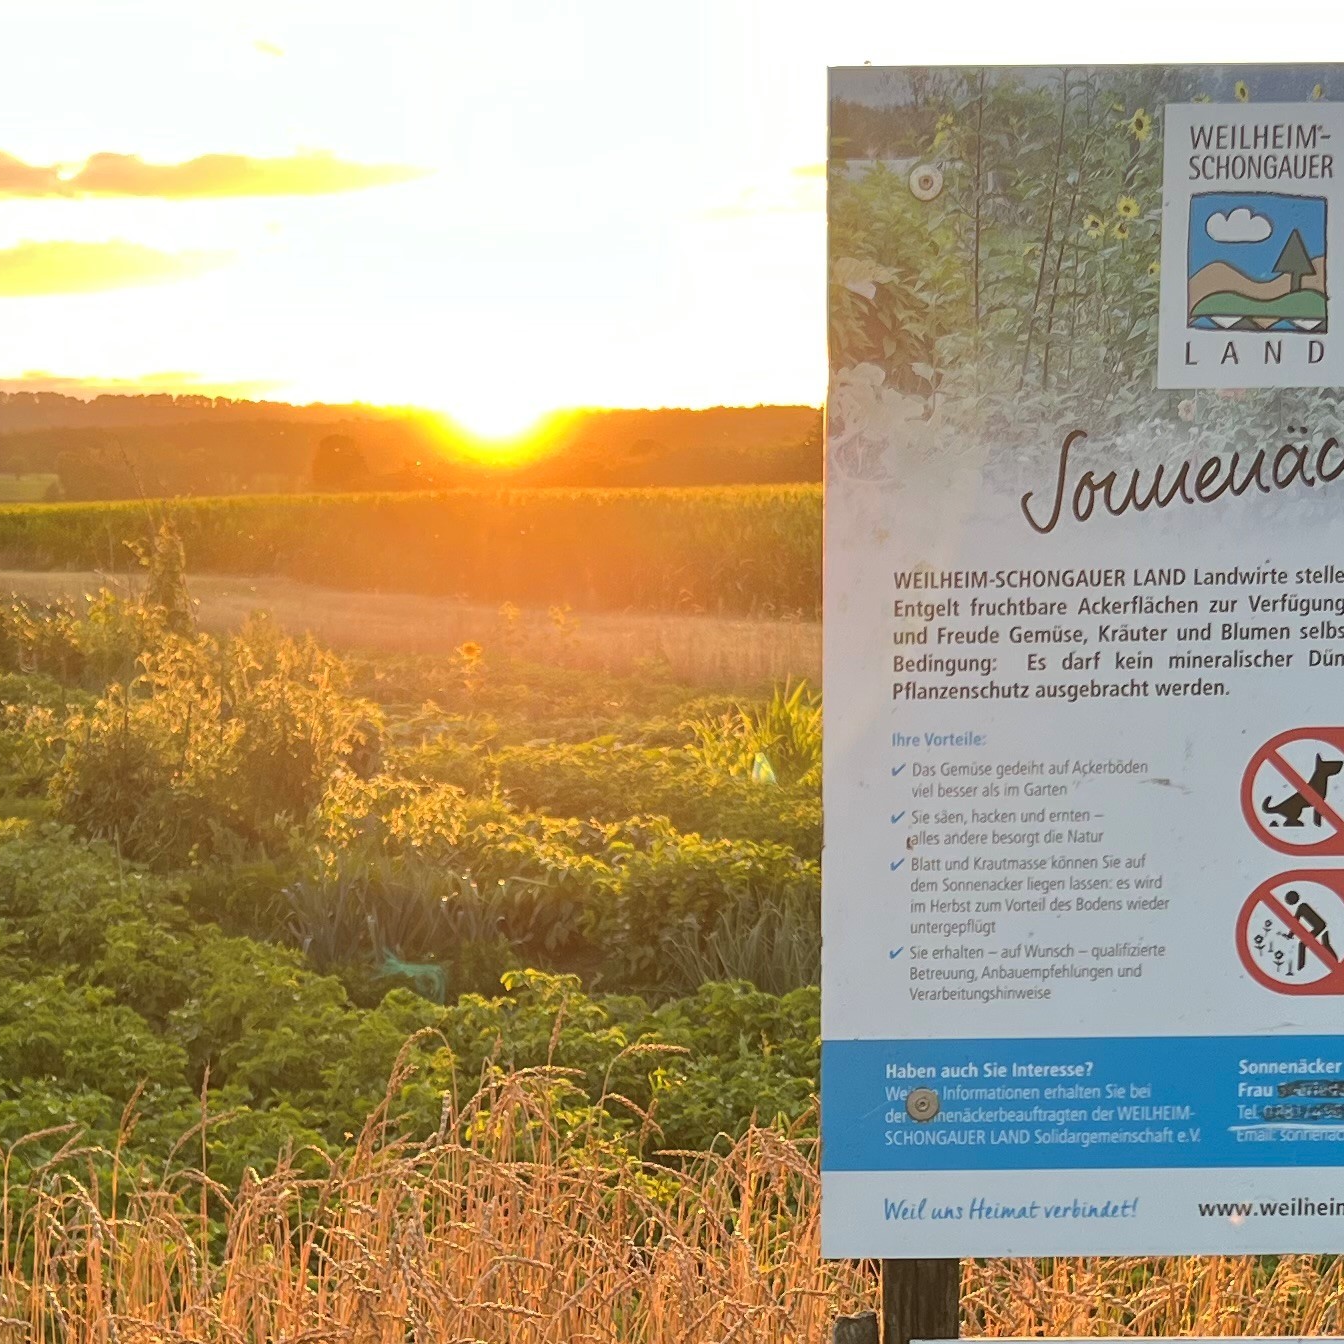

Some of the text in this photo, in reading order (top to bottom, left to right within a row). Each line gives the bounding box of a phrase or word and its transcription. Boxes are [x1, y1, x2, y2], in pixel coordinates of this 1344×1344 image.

[1189, 123, 1332, 150] WEILHEIM-
[1188, 154, 1334, 181] SCHONGAUER
[1185, 339, 1325, 366] LAND
[893, 568, 1126, 590] WEILHEIM-SCHONGAUER
[1133, 568, 1187, 587] LAND
[1193, 565, 1288, 586] Landwirte
[894, 598, 960, 622] Entgelt
[969, 596, 1068, 617] fruchtbare
[1077, 595, 1199, 615] Ackerflächen
[1208, 599, 1238, 614] zur
[893, 626, 928, 645] und
[937, 625, 1000, 645] Freude
[1009, 625, 1088, 646] Gemüse,
[1098, 624, 1168, 643] Kräuter
[1176, 622, 1212, 642] und
[1221, 621, 1291, 641] Blumen
[893, 653, 997, 677] Bedingung:
[1027, 653, 1047, 671] Es
[1061, 650, 1101, 671] darf
[1114, 650, 1153, 670] kein
[1168, 648, 1294, 669] mineralischer
[892, 677, 1230, 703] Pflanzenschutz ausgebracht werden.
[891, 730, 987, 747] Ihre Vorteile:
[912, 759, 1149, 780] Das Gemüse gedeiht auf Ackerböden
[911, 782, 1068, 799] viel besser als im Garten
[911, 809, 931, 825] Sie
[933, 809, 968, 826] säen,
[971, 808, 1017, 824] hacken
[1020, 807, 1046, 823] und
[1048, 809, 1091, 823] ernten
[911, 829, 1105, 848] alles andere besorgt die Natur
[911, 853, 1147, 872] Blatt und Krautmasse können Sie auf
[910, 874, 1163, 895] dem Sonnenacker liegen lassen: es wird
[910, 895, 1170, 914] im Herbst zum Vorteil des Bodens wieder
[910, 918, 997, 938] untergepflügt
[909, 945, 929, 960] Sie
[931, 944, 985, 960] erhalten
[1000, 943, 1023, 959] auf
[1023, 943, 1075, 958] Wunsch
[1090, 942, 1167, 961] qualifizierte
[909, 963, 1143, 984] Betreuung, Anbauempfehlungen und
[908, 985, 1052, 1004] Verarbeitungshinweise
[885, 1061, 1094, 1079] Haben auch Sie Interesse?
[1238, 1057, 1343, 1075] Sonnenäcker
[943, 1084, 1040, 1101] Informationen
[1044, 1083, 1102, 1100] erhalten
[1104, 1083, 1127, 1099] Sie
[1129, 1082, 1153, 1099] bei
[1237, 1081, 1274, 1098] Frau
[884, 1107, 907, 1123] der
[1091, 1105, 1115, 1122] der
[1117, 1105, 1196, 1121] WEILHEIM-
[884, 1126, 1202, 1148] SCHONGAUER LAND Solidargemeinschaft e.V.
[884, 1196, 1139, 1221] Weil uns Heimat verbindet!
